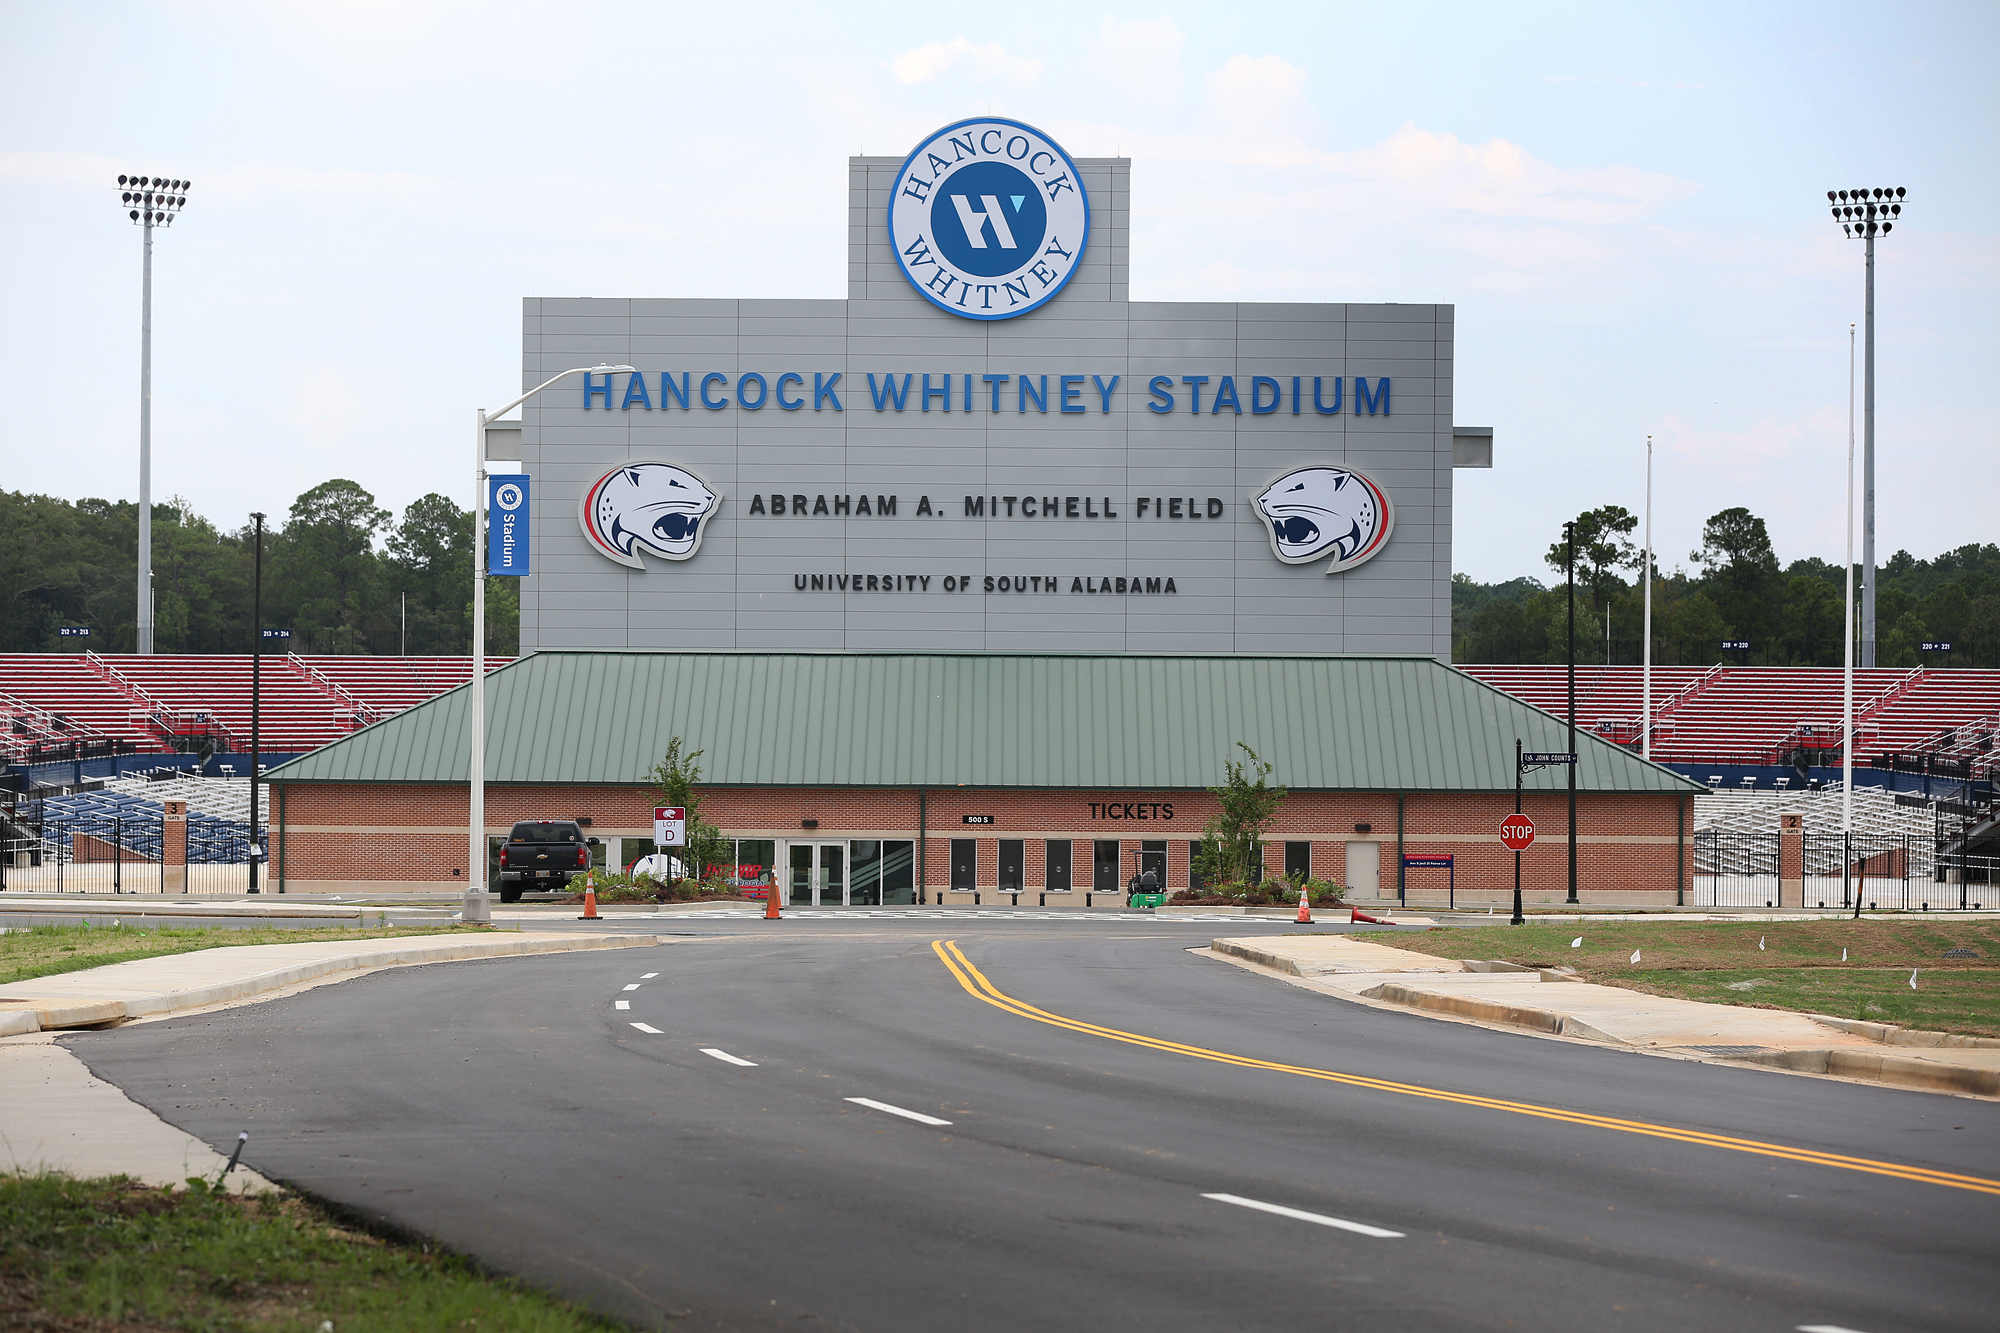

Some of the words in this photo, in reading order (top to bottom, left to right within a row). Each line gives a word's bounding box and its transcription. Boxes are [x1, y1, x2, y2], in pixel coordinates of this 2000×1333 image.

[902, 130, 1074, 205] HANCOCK
[903, 233, 1073, 309] WHITNEY
[583, 371, 843, 411] HANCOCK
[866, 372, 1120, 413] WHITNEY
[1147, 375, 1391, 415] STADIUM
[749, 494, 897, 516] ABRAHAM
[916, 495, 944, 517] A.
[964, 495, 1118, 518] MITCHELL
[1136, 497, 1224, 519] FIELD
[503, 513, 516, 567] Stadium
[794, 574, 931, 592] UNIVERSITY
[943, 575, 971, 593] OF
[983, 576, 1057, 594] SOUTH
[1070, 576, 1177, 595] ALABAMA
[1551, 754, 1571, 762] COUNTS
[170, 803, 178, 814] 3
[1088, 802, 1174, 820] TICKETS
[1789, 816, 1797, 828] 2
[665, 830, 675, 842] D
[1501, 825, 1533, 839] STOP
